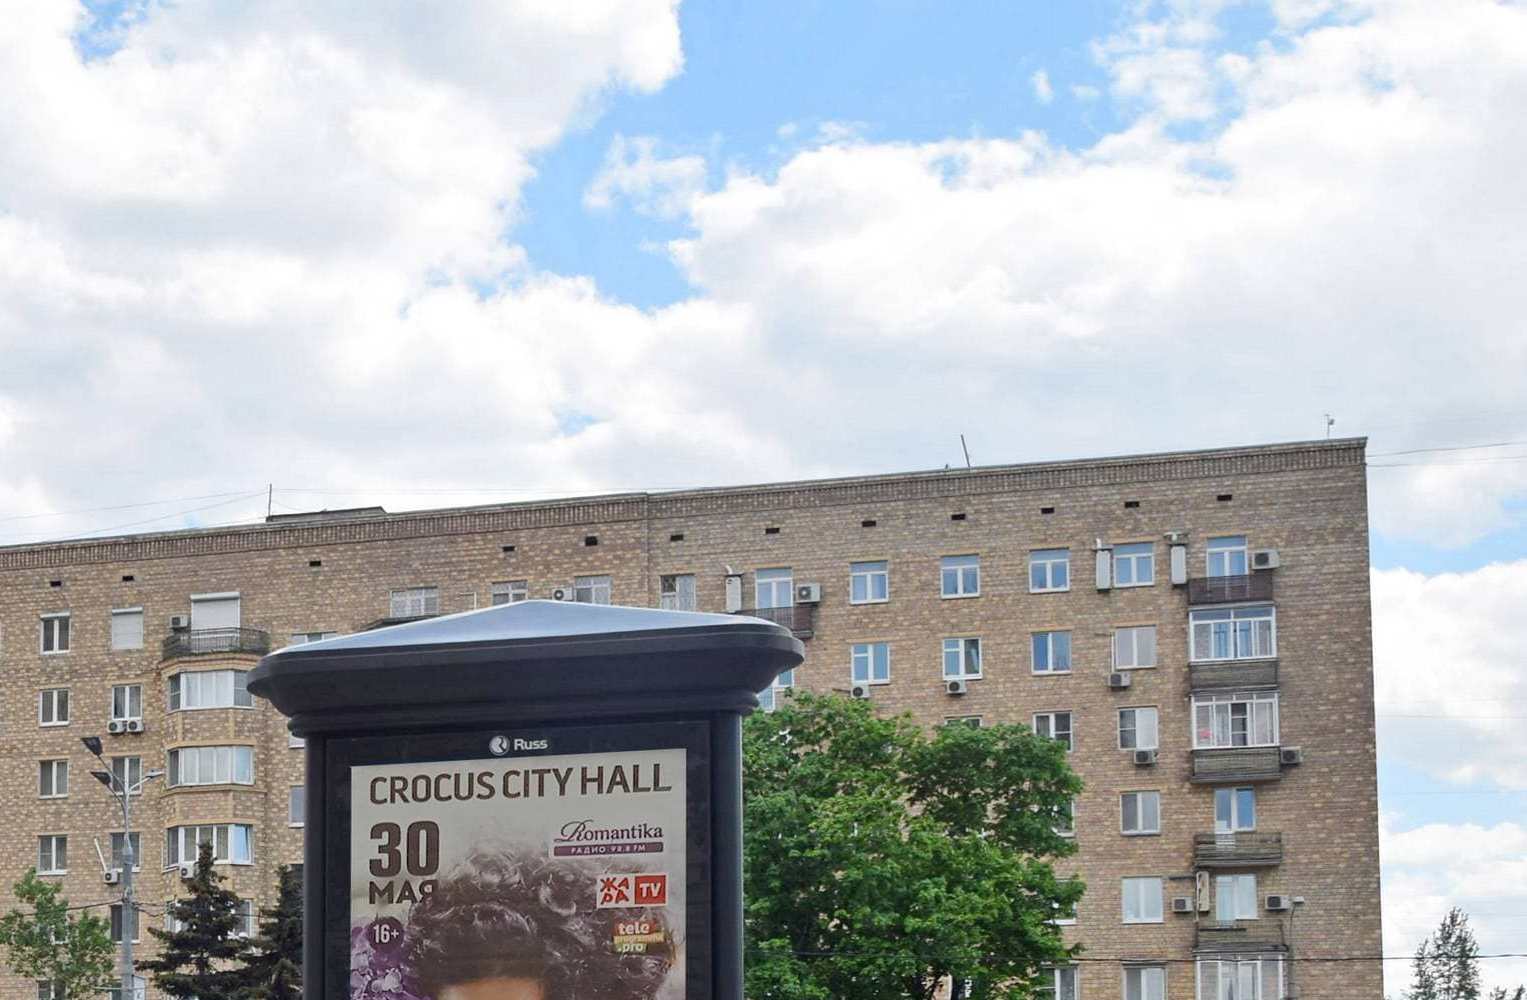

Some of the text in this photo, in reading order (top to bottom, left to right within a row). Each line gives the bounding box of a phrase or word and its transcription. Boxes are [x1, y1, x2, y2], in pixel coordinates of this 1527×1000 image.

[514, 739, 548, 750] Russ
[370, 763, 672, 805] CROCUS CITY HALL
[554, 819, 663, 842] Romantika
[369, 820, 440, 878] 30
[571, 847, 606, 855] РАДИО
[633, 844, 646, 852] FM
[369, 880, 437, 905] МАЯ
[639, 883, 661, 897] TV
[373, 924, 400, 943] 16+
[617, 922, 650, 935] tele
